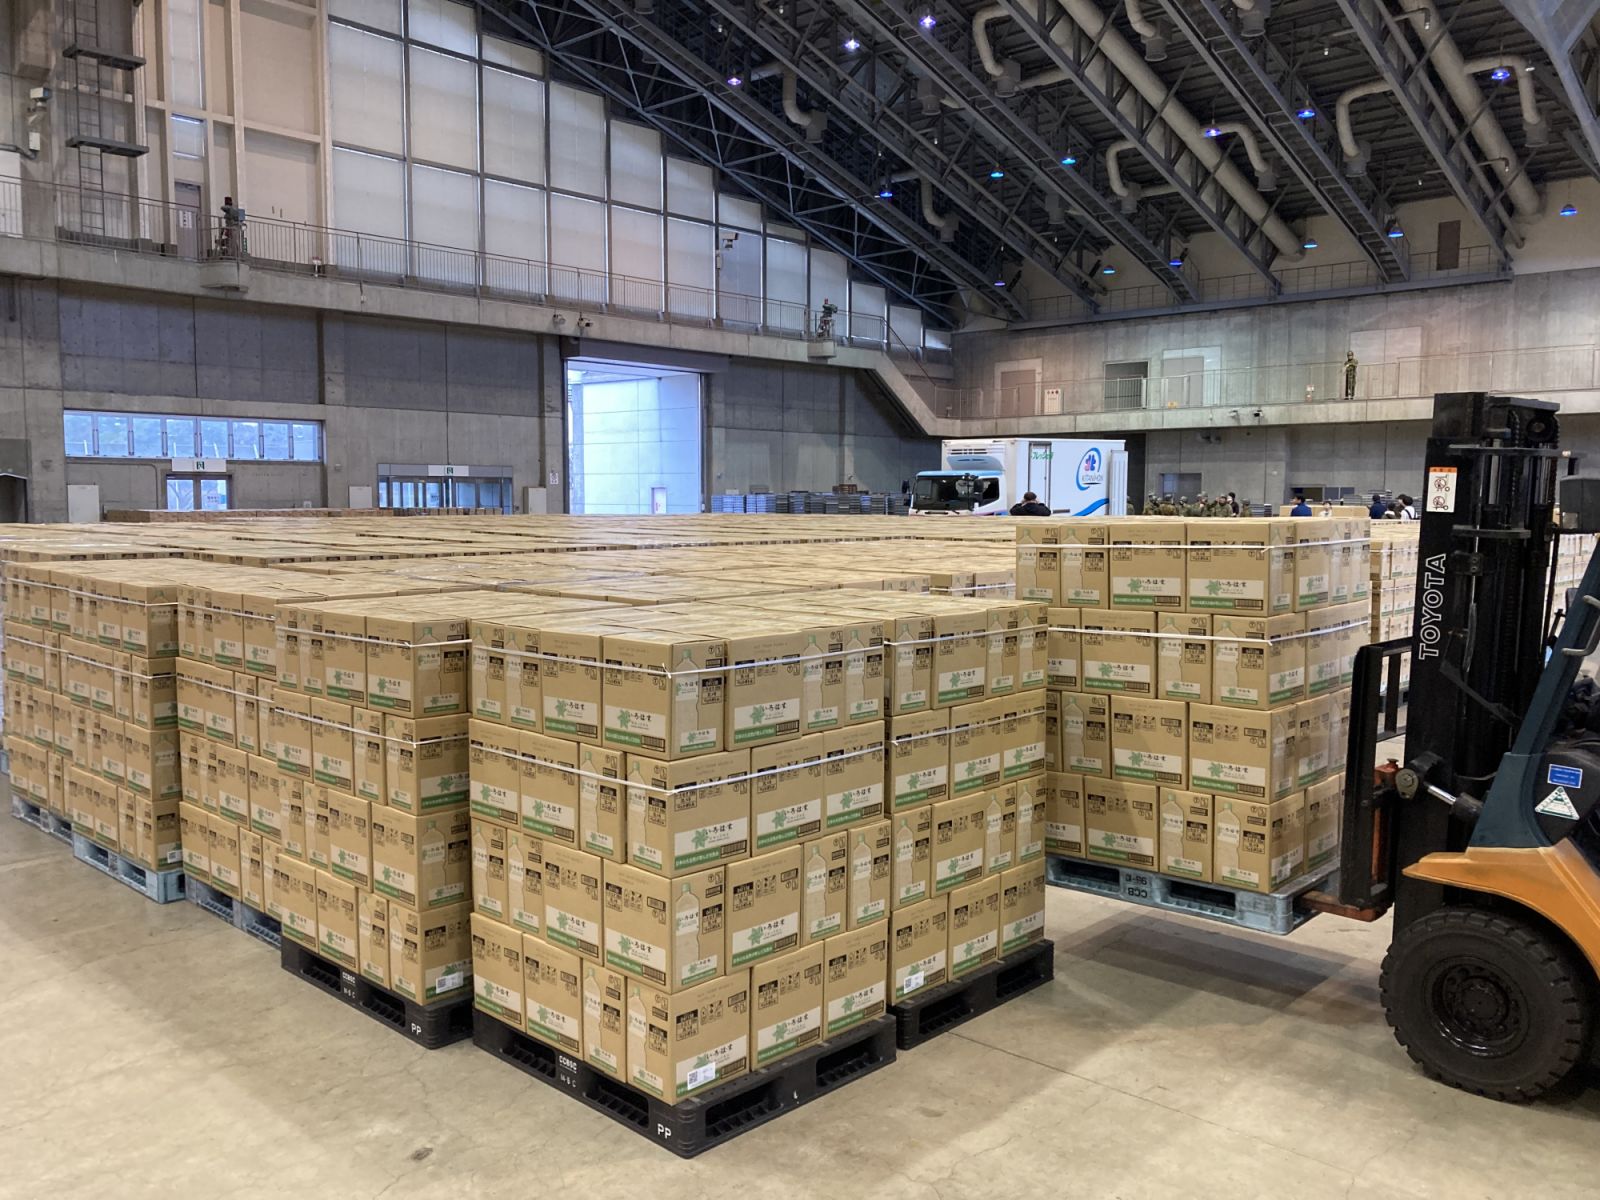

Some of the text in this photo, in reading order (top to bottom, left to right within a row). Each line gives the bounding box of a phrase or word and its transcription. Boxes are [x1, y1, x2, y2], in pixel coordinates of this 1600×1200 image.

[1419, 553, 1446, 660] TOYOTA
[411, 1023, 422, 1035] PP
[657, 1123, 672, 1139] PP
